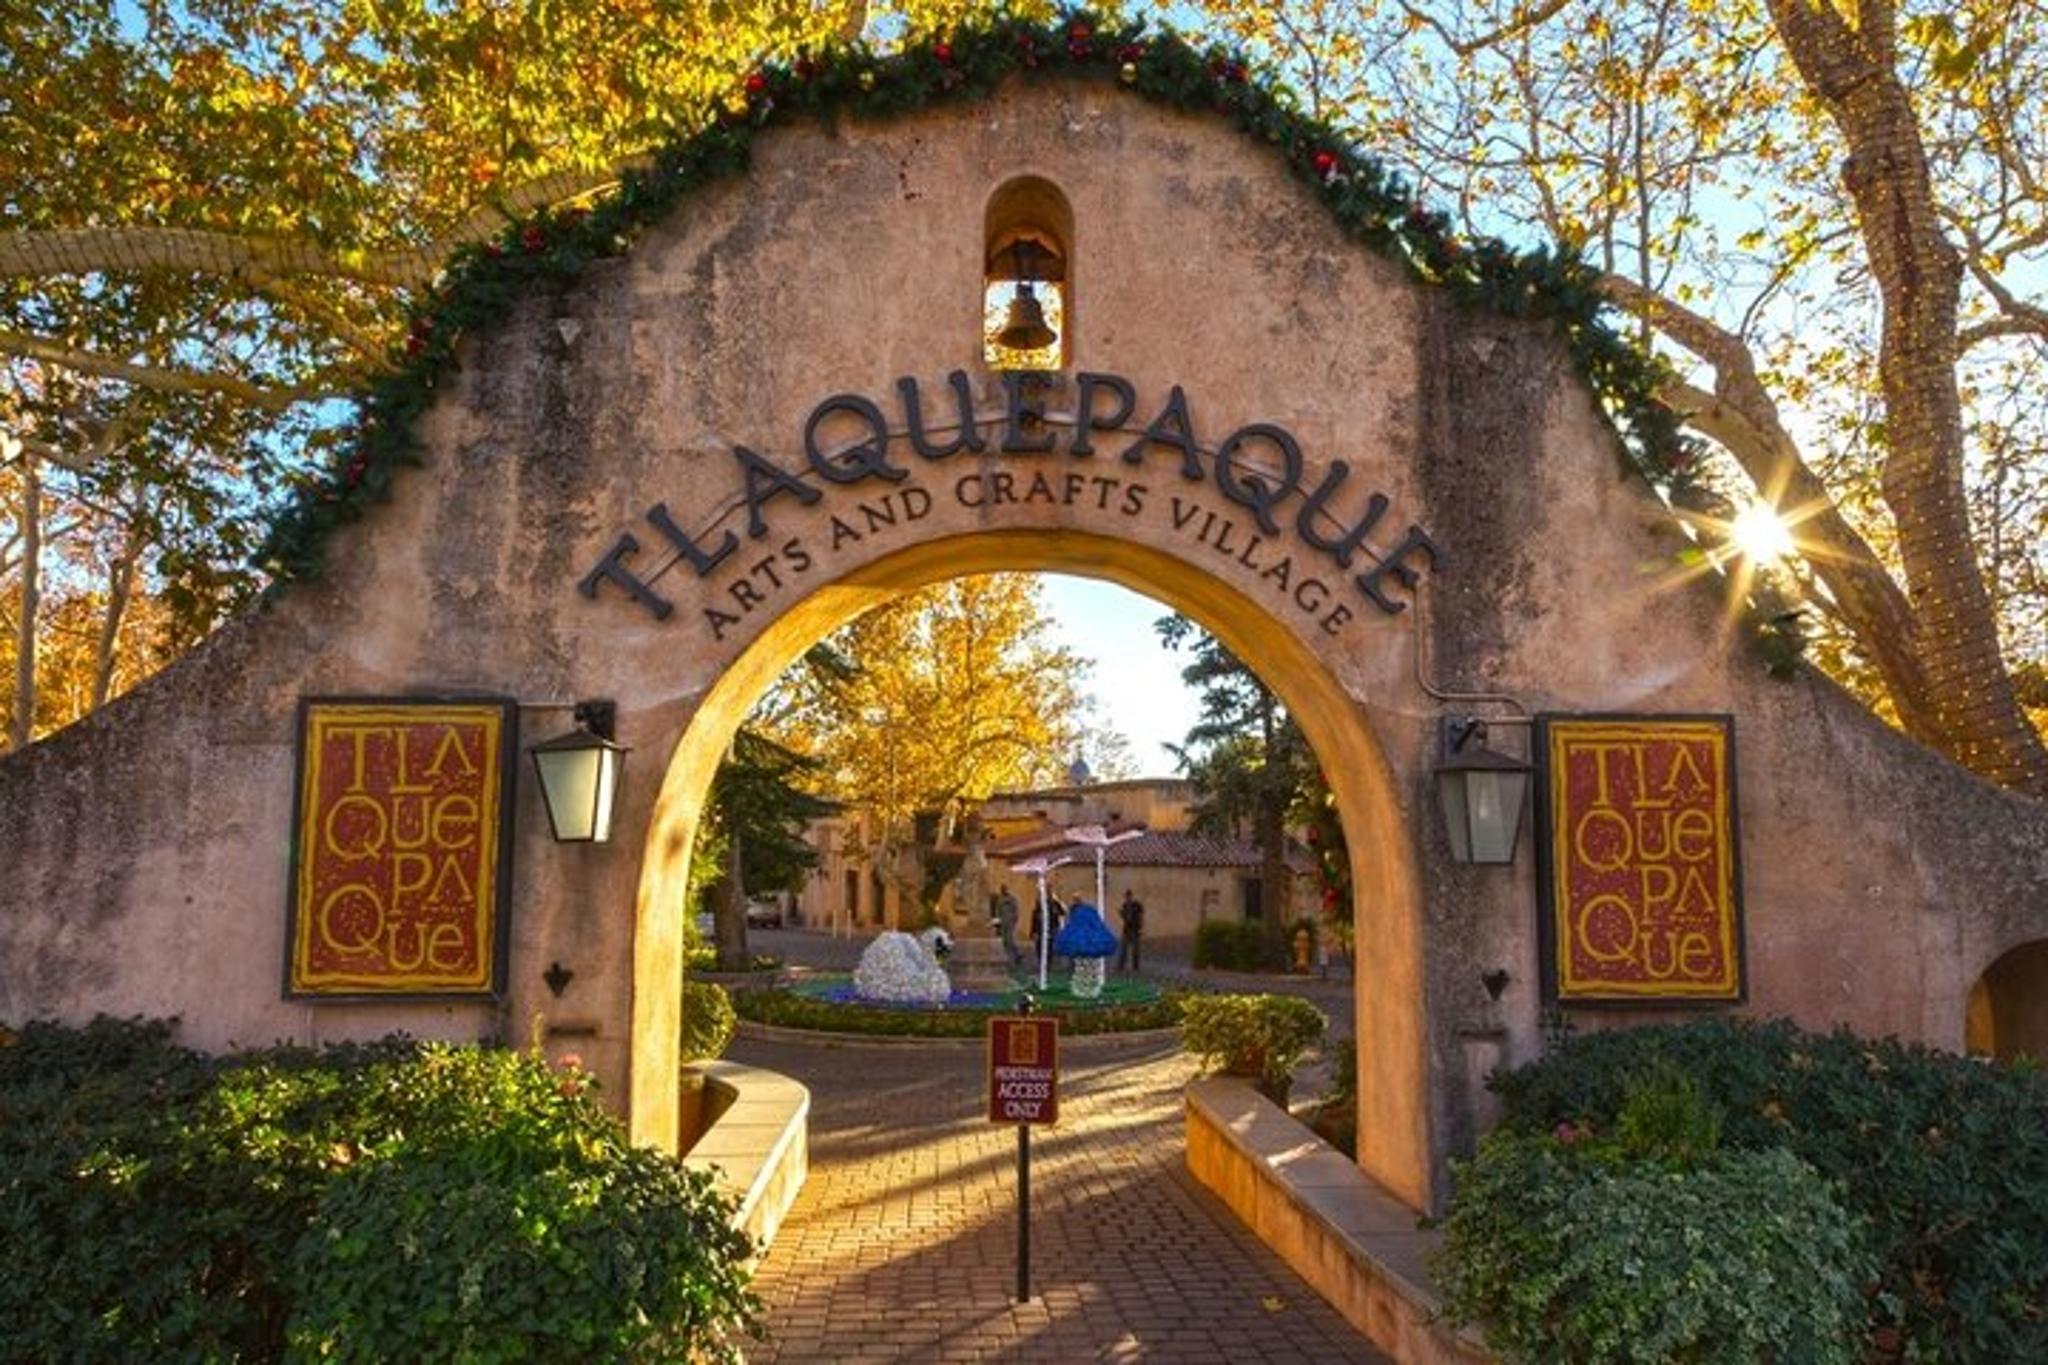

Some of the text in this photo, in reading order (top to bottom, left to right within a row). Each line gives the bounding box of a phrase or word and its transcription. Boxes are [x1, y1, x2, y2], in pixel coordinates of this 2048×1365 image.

[577, 369, 1449, 621] TLAQUEPAQUE
[703, 472, 1353, 641] ARTS AND CRAFTS VILLAGE
[998, 1082, 1051, 1099] ACCESS
[1004, 1100, 1042, 1118] ONLY
